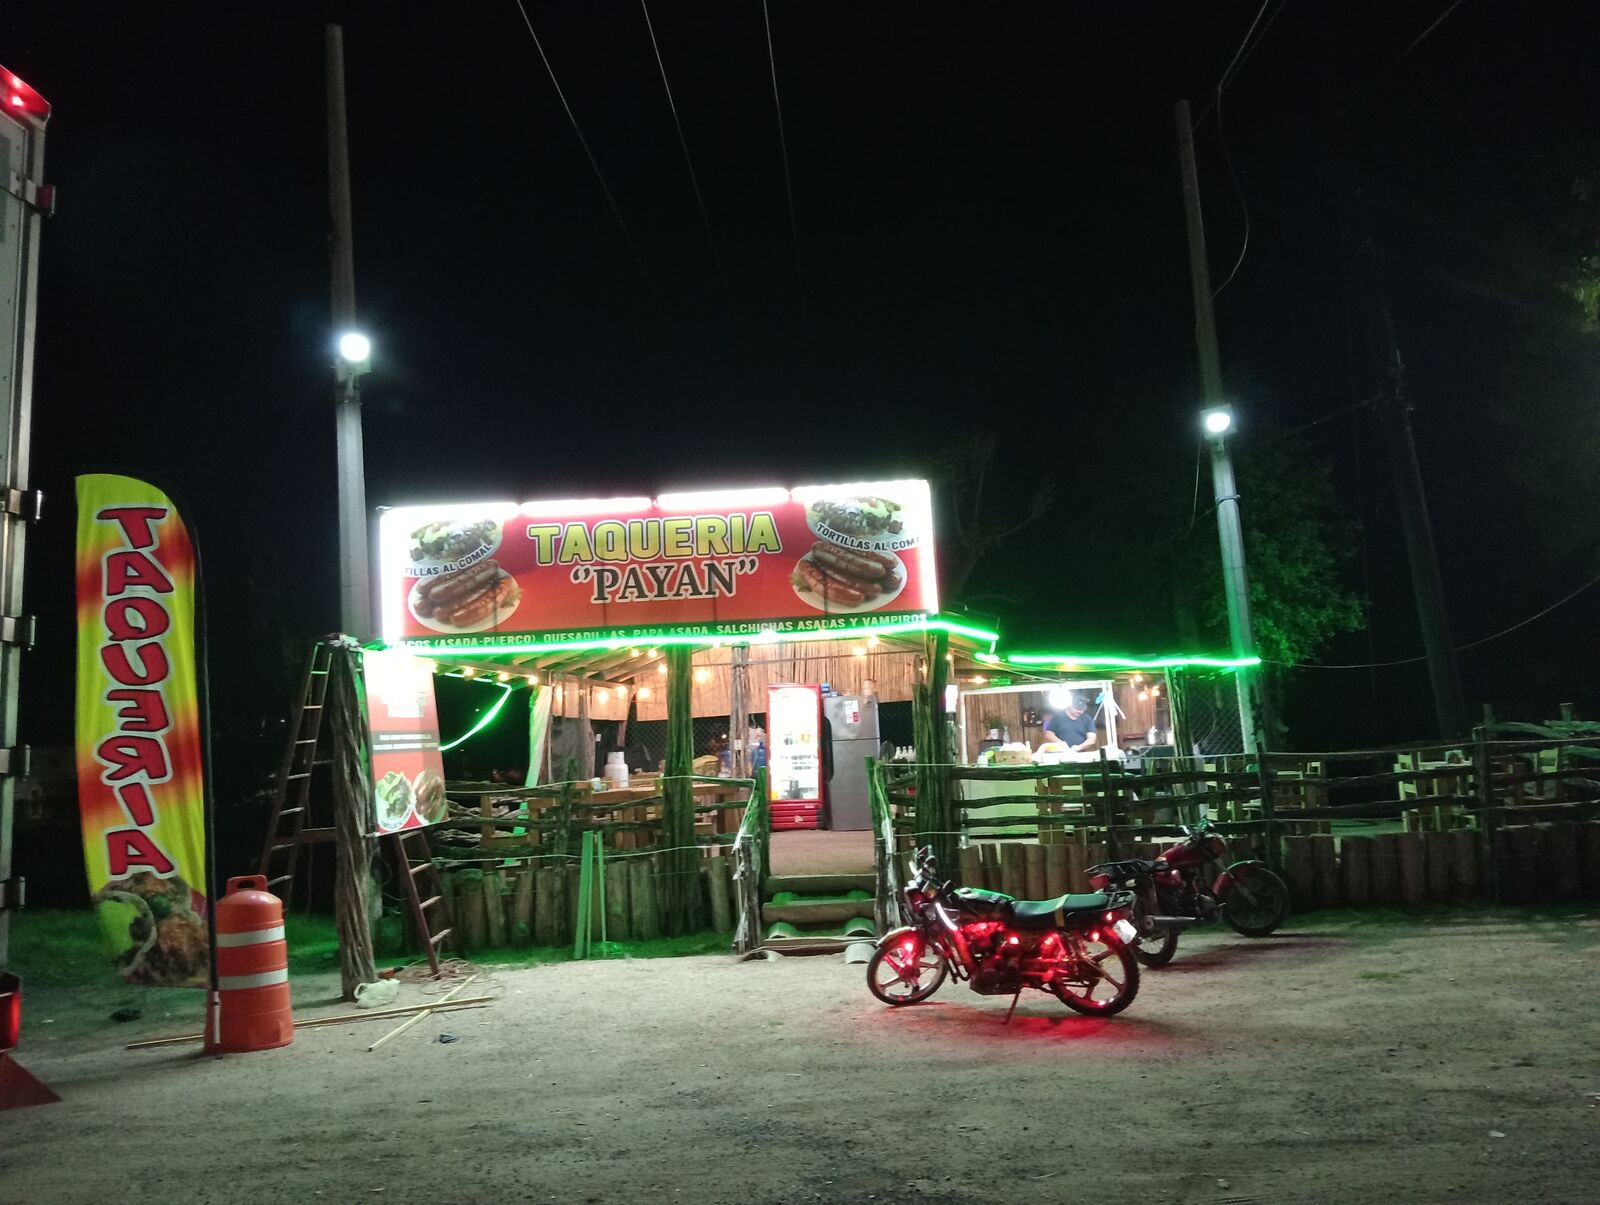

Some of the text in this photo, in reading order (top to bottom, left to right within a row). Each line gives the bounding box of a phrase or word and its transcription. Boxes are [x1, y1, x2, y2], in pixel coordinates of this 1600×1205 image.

[527, 511, 783, 566] TAQUERIA
[817, 523, 919, 551] TORTILLAS AL COM
[443, 563, 456, 573] AL
[458, 543, 493, 568] COMAL
[571, 556, 759, 604] “PAYAN”
[716, 621, 793, 634] SALCHICHAS
[797, 619, 846, 631] ASADAS
[850, 618, 859, 627] Y
[862, 613, 928, 627] VAMPIROS
